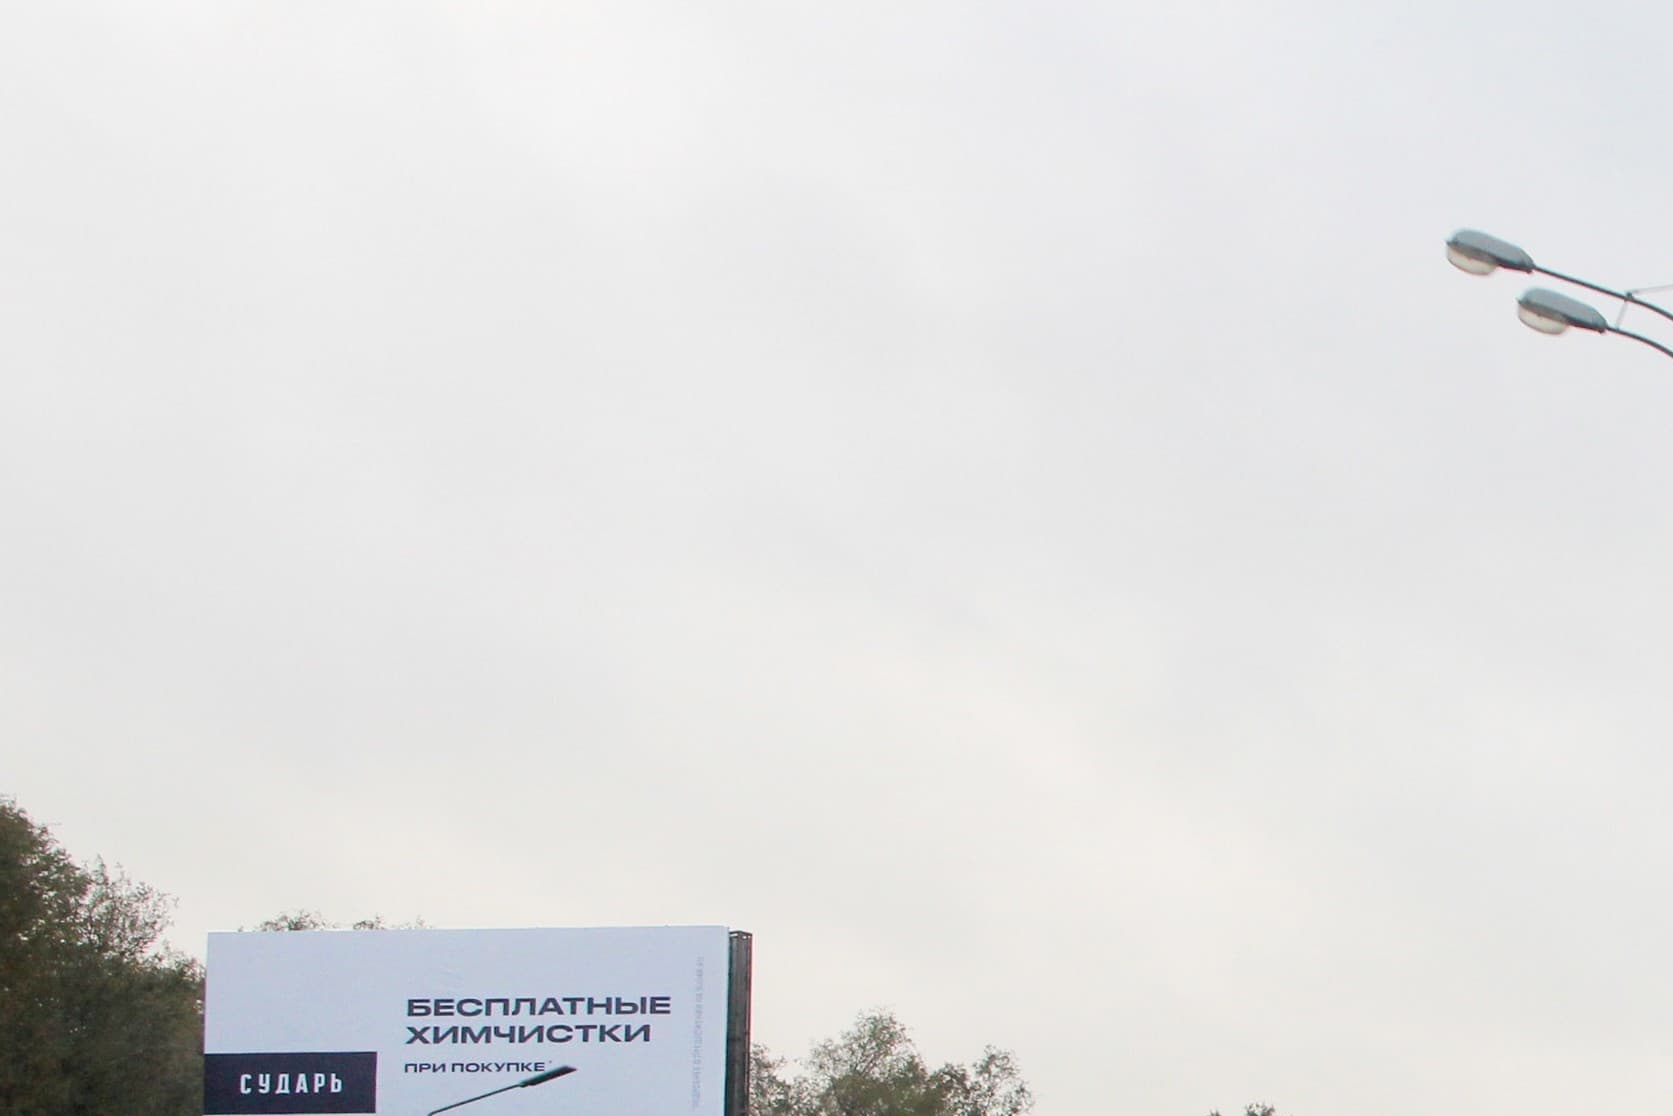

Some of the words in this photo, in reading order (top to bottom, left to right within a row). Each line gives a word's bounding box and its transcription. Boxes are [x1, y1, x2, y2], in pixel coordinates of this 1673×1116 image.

[407, 996, 672, 1017] БЕСПЛАТНЫЕ
[405, 1024, 651, 1045] ХИМЧИСТКИ
[404, 1062, 447, 1074] ПРИ
[240, 1073, 343, 1094] СУДАРЬ
